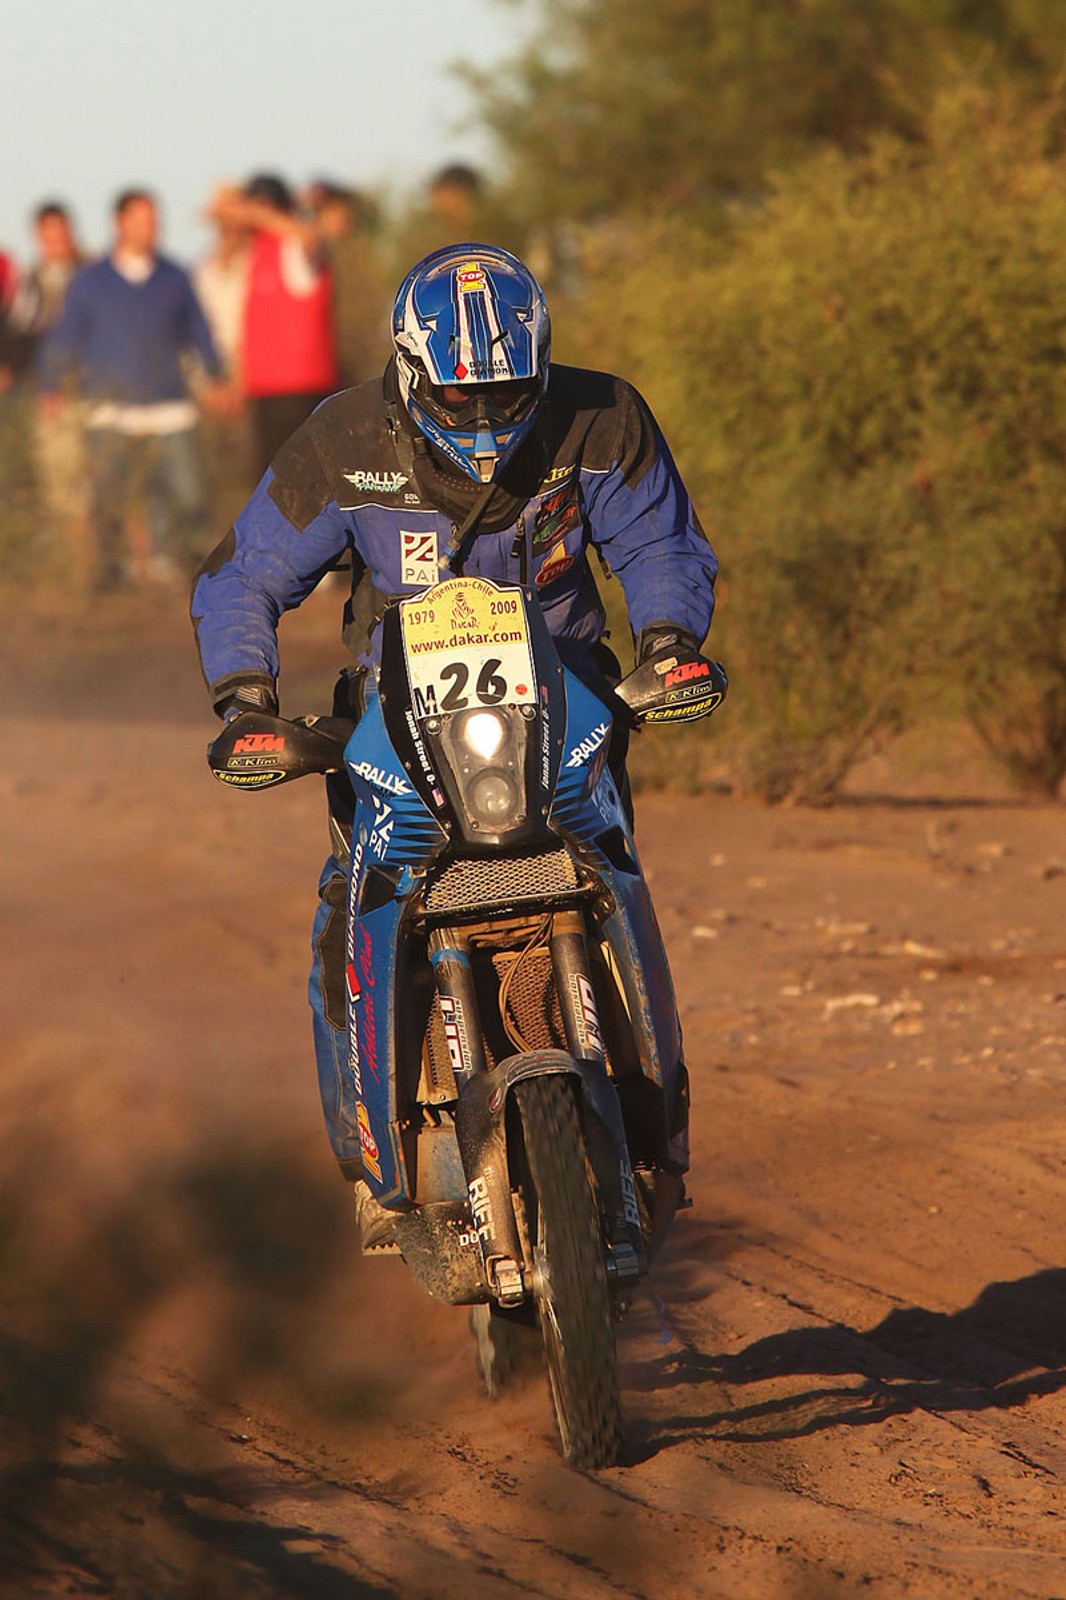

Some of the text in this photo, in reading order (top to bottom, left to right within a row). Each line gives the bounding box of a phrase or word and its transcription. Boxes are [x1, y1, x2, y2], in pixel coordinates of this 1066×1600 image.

[461, 273, 483, 281] TOP
[469, 359, 505, 368] DOUBLE
[353, 471, 404, 485] RALLY
[405, 567, 436, 583] PAi
[427, 579, 494, 605] Argentina-Chile
[408, 609, 436, 626] 1979
[489, 599, 518, 616] 2009
[410, 630, 523, 654] www.dakar.com
[413, 658, 508, 717] M 26
[664, 661, 710, 688] KTM
[232, 733, 285, 755] KTM
[404, 710, 417, 741] Jonah
[414, 737, 431, 772] Street
[542, 721, 551, 755] Street
[569, 723, 609, 764] RALLY
[357, 761, 408, 794] RALLY
[541, 754, 551, 790] Jonah
[368, 829, 389, 862] PAi
[347, 842, 364, 1097] DOUBLE DIAMOND
[569, 974, 587, 1045] suspension
[455, 999, 472, 1070] suspension
